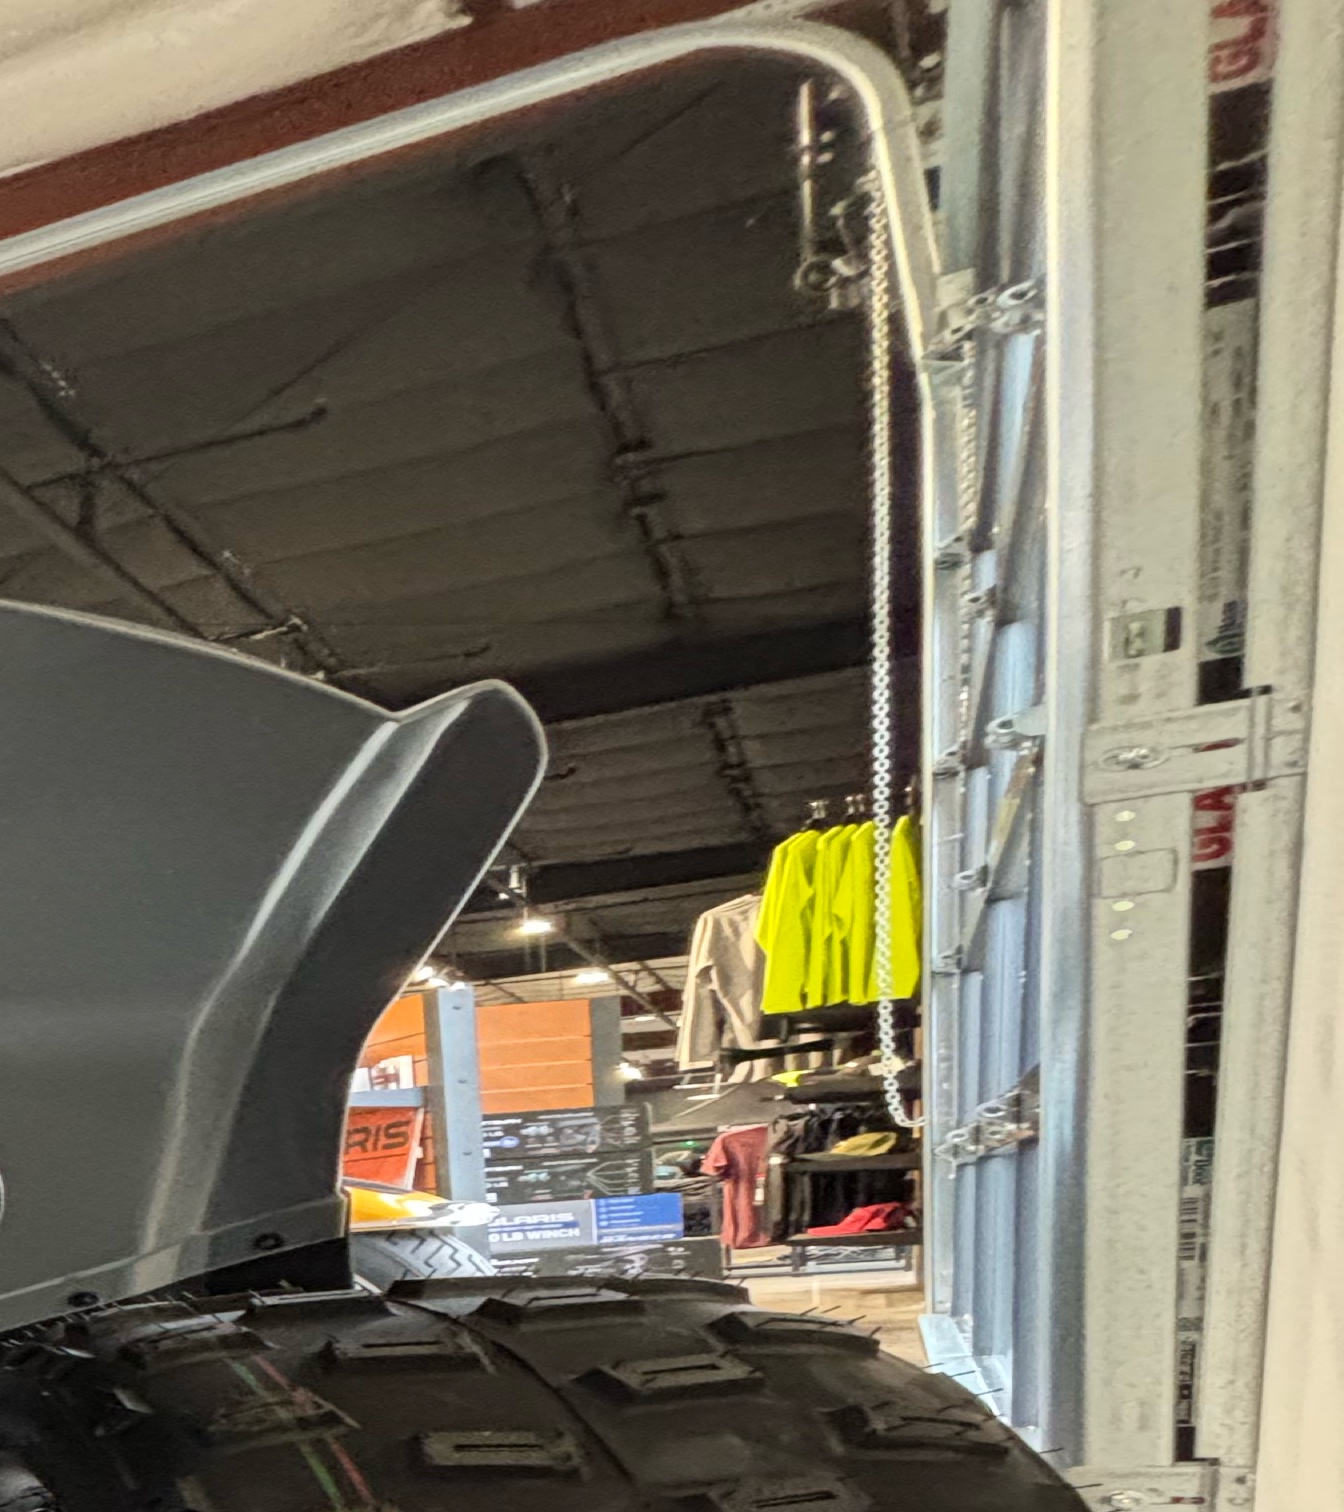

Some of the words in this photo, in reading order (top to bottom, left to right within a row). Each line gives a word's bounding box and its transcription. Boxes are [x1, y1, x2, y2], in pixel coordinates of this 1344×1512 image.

[346, 1119, 411, 1154] RIS
[488, 1212, 575, 1227] LARIS
[525, 1228, 580, 1240] WINCH
